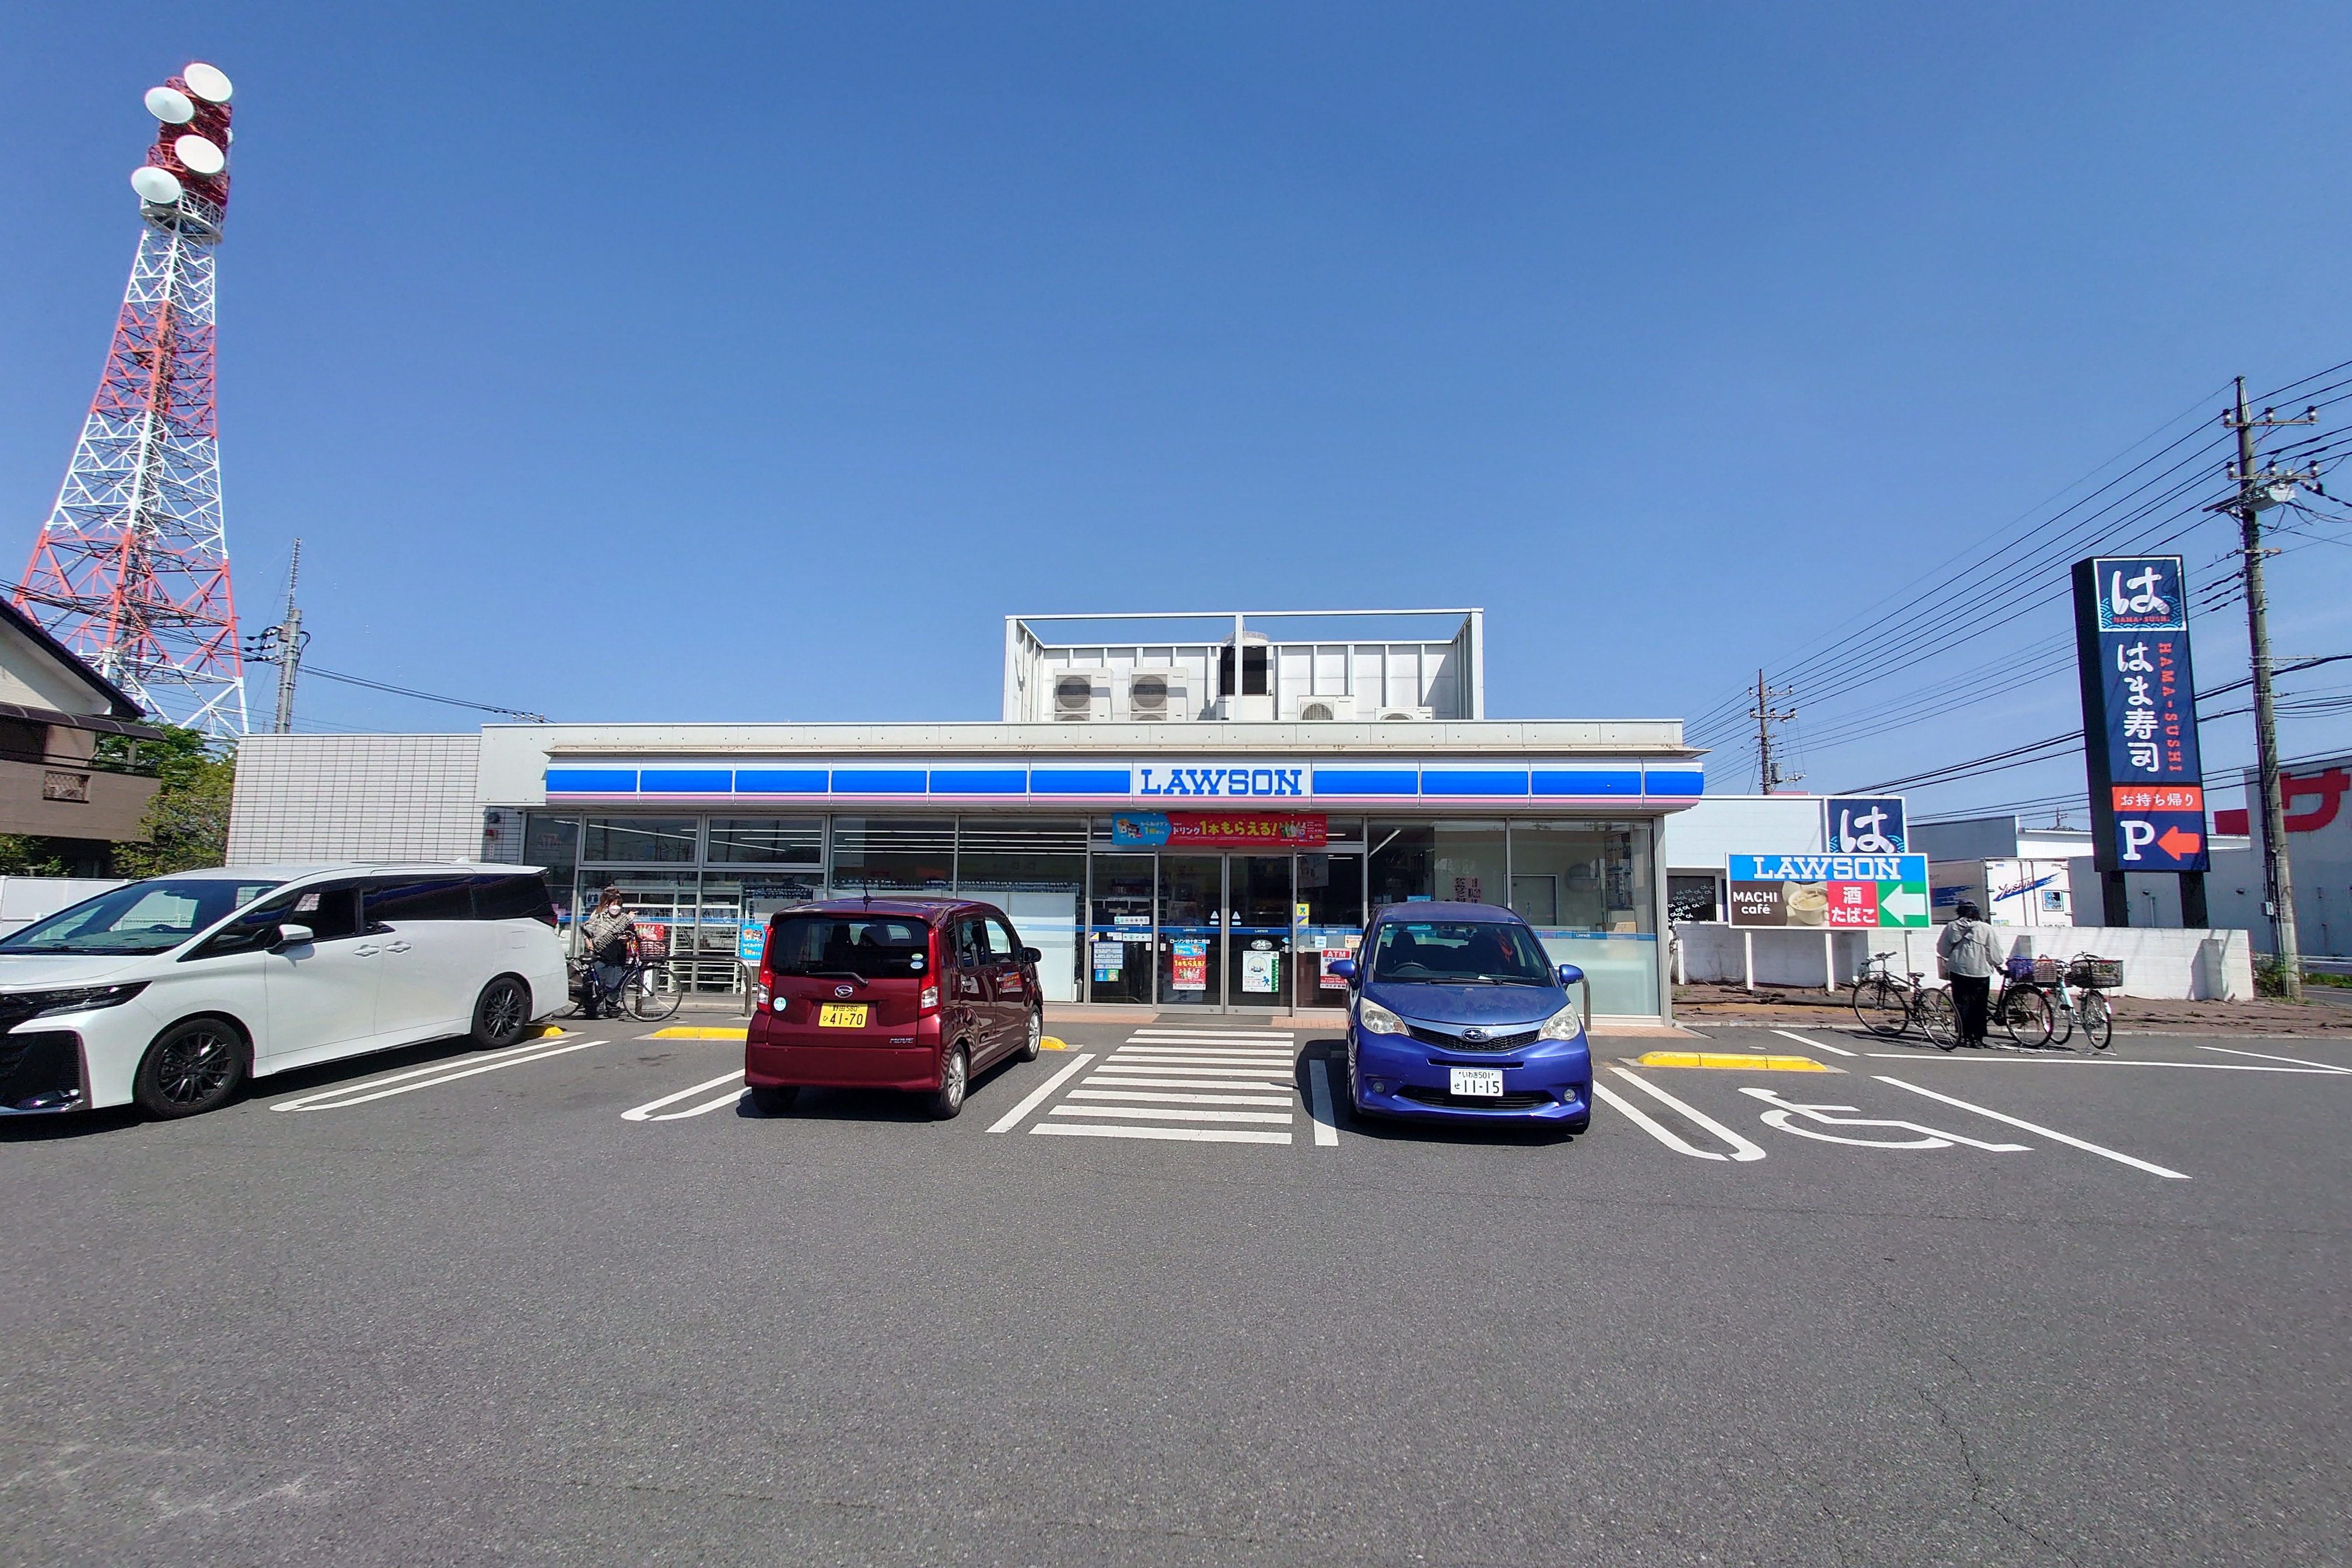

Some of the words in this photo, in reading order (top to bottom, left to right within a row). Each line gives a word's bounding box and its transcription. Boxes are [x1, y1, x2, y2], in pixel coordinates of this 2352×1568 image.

[2111, 566, 2171, 616] は
[2116, 642, 2160, 772] はま寿司
[2158, 642, 2183, 772] HAMA-SUSHI
[1140, 769, 1303, 795] LAWSON
[2120, 793, 2194, 807] お持ち帰り
[1840, 806, 1895, 853] は
[2119, 820, 2155, 861] P
[1752, 856, 1902, 880] LAWSON
[1732, 891, 1777, 904] MACHI
[1842, 886, 1863, 905] 酒
[1741, 904, 1771, 915] café
[1831, 907, 1876, 923] たばこ
[830, 1013, 863, 1025] 41-70
[1464, 1080, 1500, 1094] 11-15
